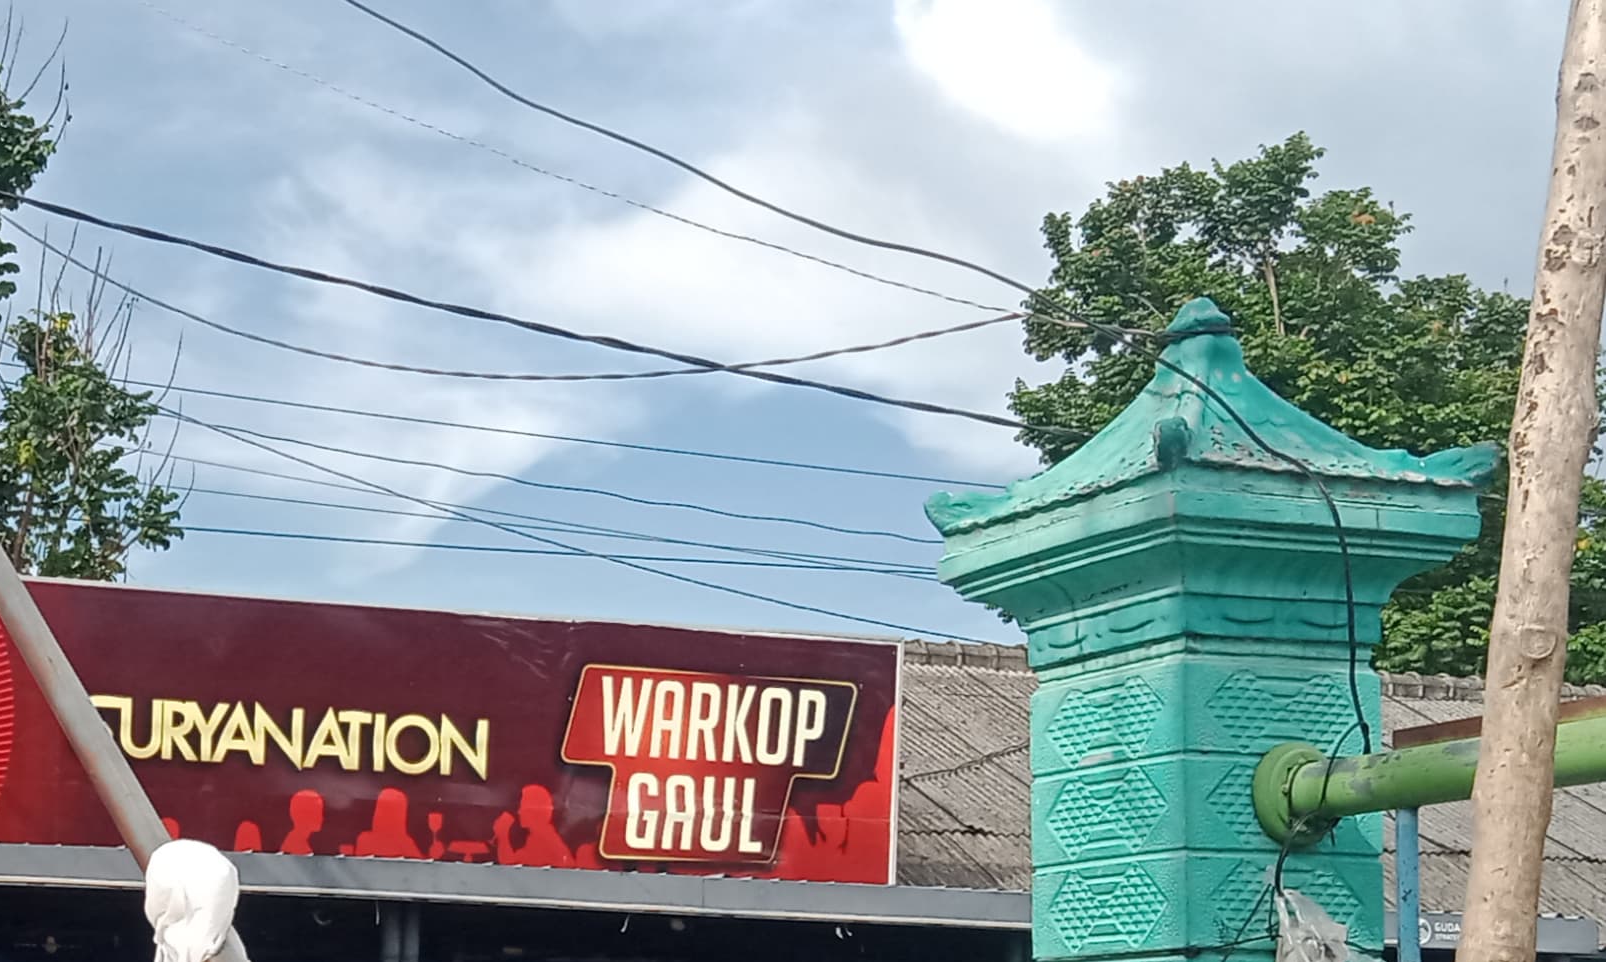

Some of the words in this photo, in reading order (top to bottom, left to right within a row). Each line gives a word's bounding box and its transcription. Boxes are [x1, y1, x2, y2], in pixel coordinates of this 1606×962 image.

[601, 675, 830, 770] WARKOP
[625, 772, 764, 855] GAUL
[1434, 922, 1461, 932] GUDA
